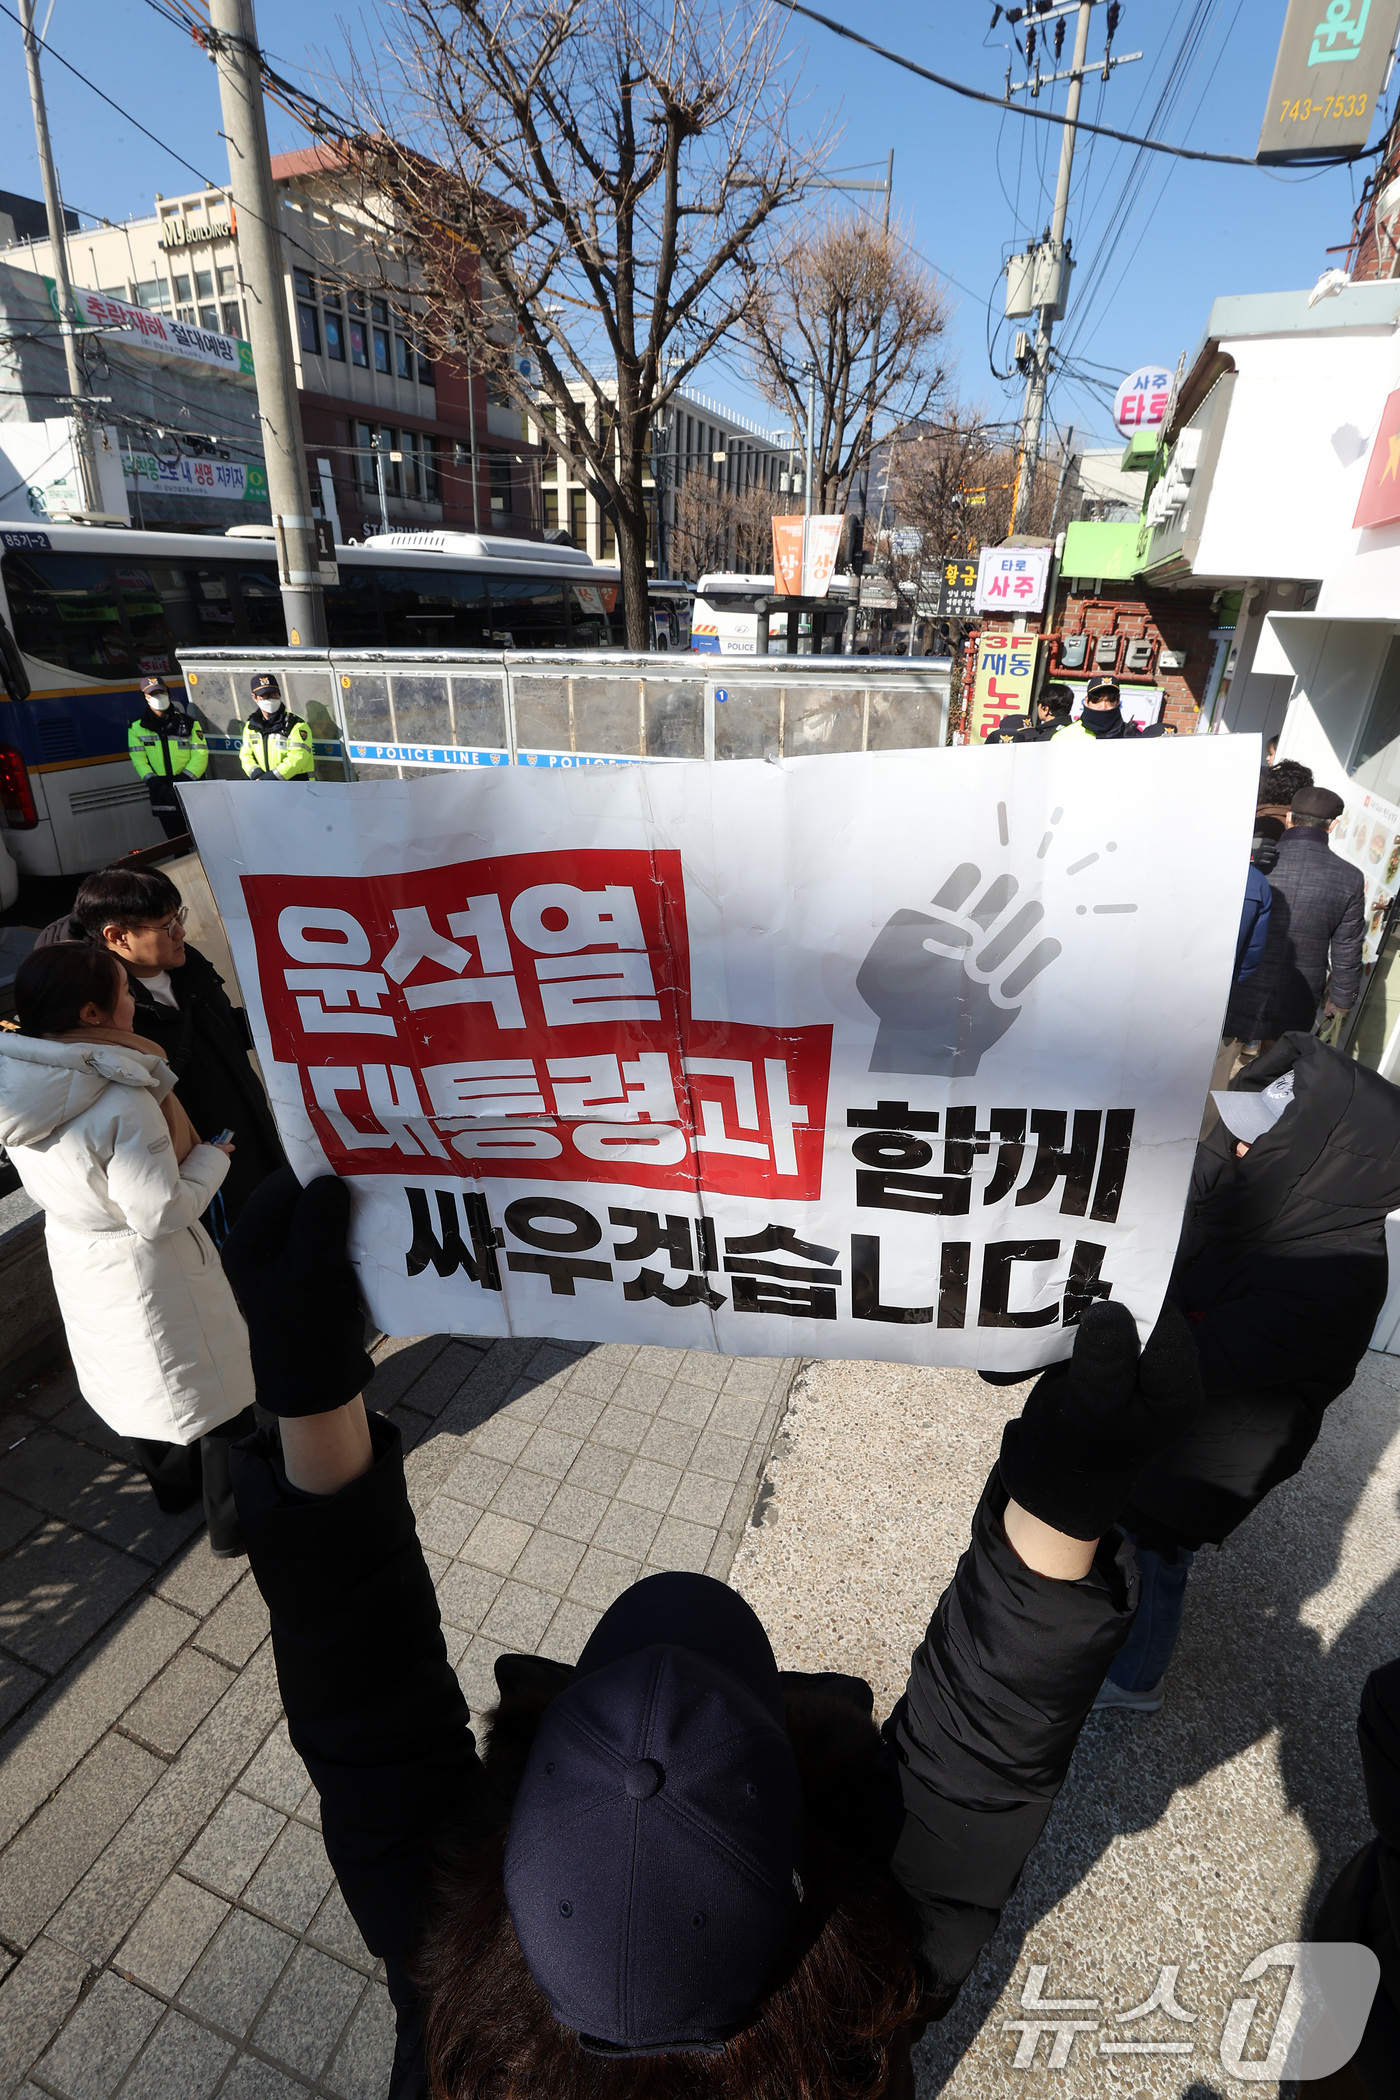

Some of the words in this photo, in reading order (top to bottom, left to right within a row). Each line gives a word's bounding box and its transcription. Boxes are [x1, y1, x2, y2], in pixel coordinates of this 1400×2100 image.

[1280, 93, 1367, 122] 743-7533
[186, 222, 229, 243] BUILDING
[86, 296, 168, 341] 추락재해
[169, 322, 234, 361] 절대예방
[1133, 374, 1167, 390] 사주
[1119, 392, 1169, 426] 타로
[194, 462, 214, 487] 생명
[216, 465, 244, 489] 지키자
[813, 554, 833, 580] 상
[944, 563, 978, 587] 황금
[1001, 559, 1027, 572] 타로
[987, 575, 1035, 598] 사주
[727, 643, 754, 652] POLICE
[985, 636, 1035, 649] 3F
[981, 653, 1032, 676] 재동
[376, 746, 435, 761] POLICE
[444, 751, 480, 764] LINE
[277, 883, 660, 1038] 윤석열
[307, 1053, 811, 1176] 대통령과
[847, 1101, 1136, 1223] 함께
[405, 1187, 1113, 1331] 싸우겠습니다
